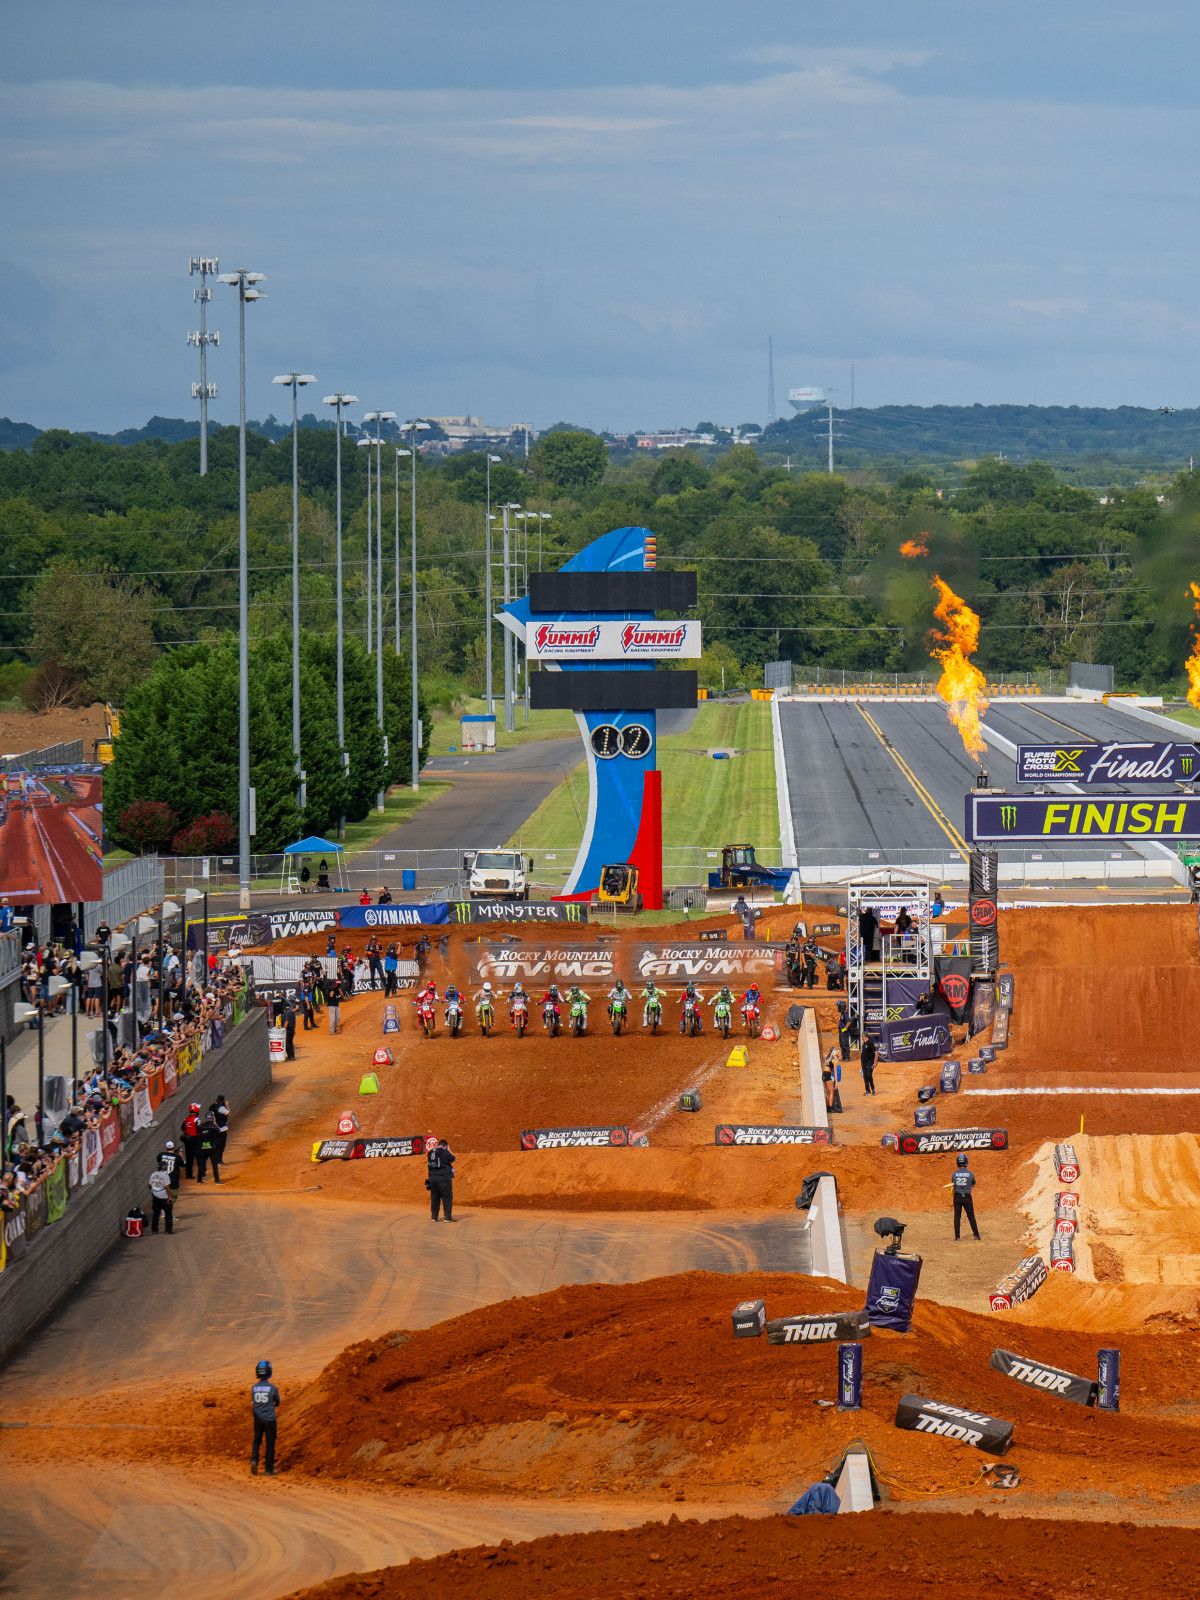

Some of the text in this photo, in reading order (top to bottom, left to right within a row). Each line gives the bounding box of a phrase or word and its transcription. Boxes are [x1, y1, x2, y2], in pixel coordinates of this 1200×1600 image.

[536, 624, 600, 651] SUMMIT
[622, 623, 686, 651] SUMMIT
[1087, 743, 1175, 782] Finals
[1042, 803, 1187, 833] FINISH
[289, 911, 334, 922] MOUNTAIN
[375, 909, 421, 925] YAMAHA
[478, 905, 559, 918] MONSTER
[498, 949, 613, 961] ROCKY MOUNTAIN
[660, 948, 775, 959] ROCKY MOUNTAIN
[354, 980, 381, 991] ROCY
[913, 1026, 939, 1050] Finals
[571, 1130, 609, 1138] MOUNTAIN
[953, 1132, 991, 1141] MOUNTAIN
[876, 1296, 899, 1308] Finals
[783, 1323, 838, 1341] THOR
[1007, 1360, 1072, 1394] THOR
[915, 1413, 983, 1447] THOR
